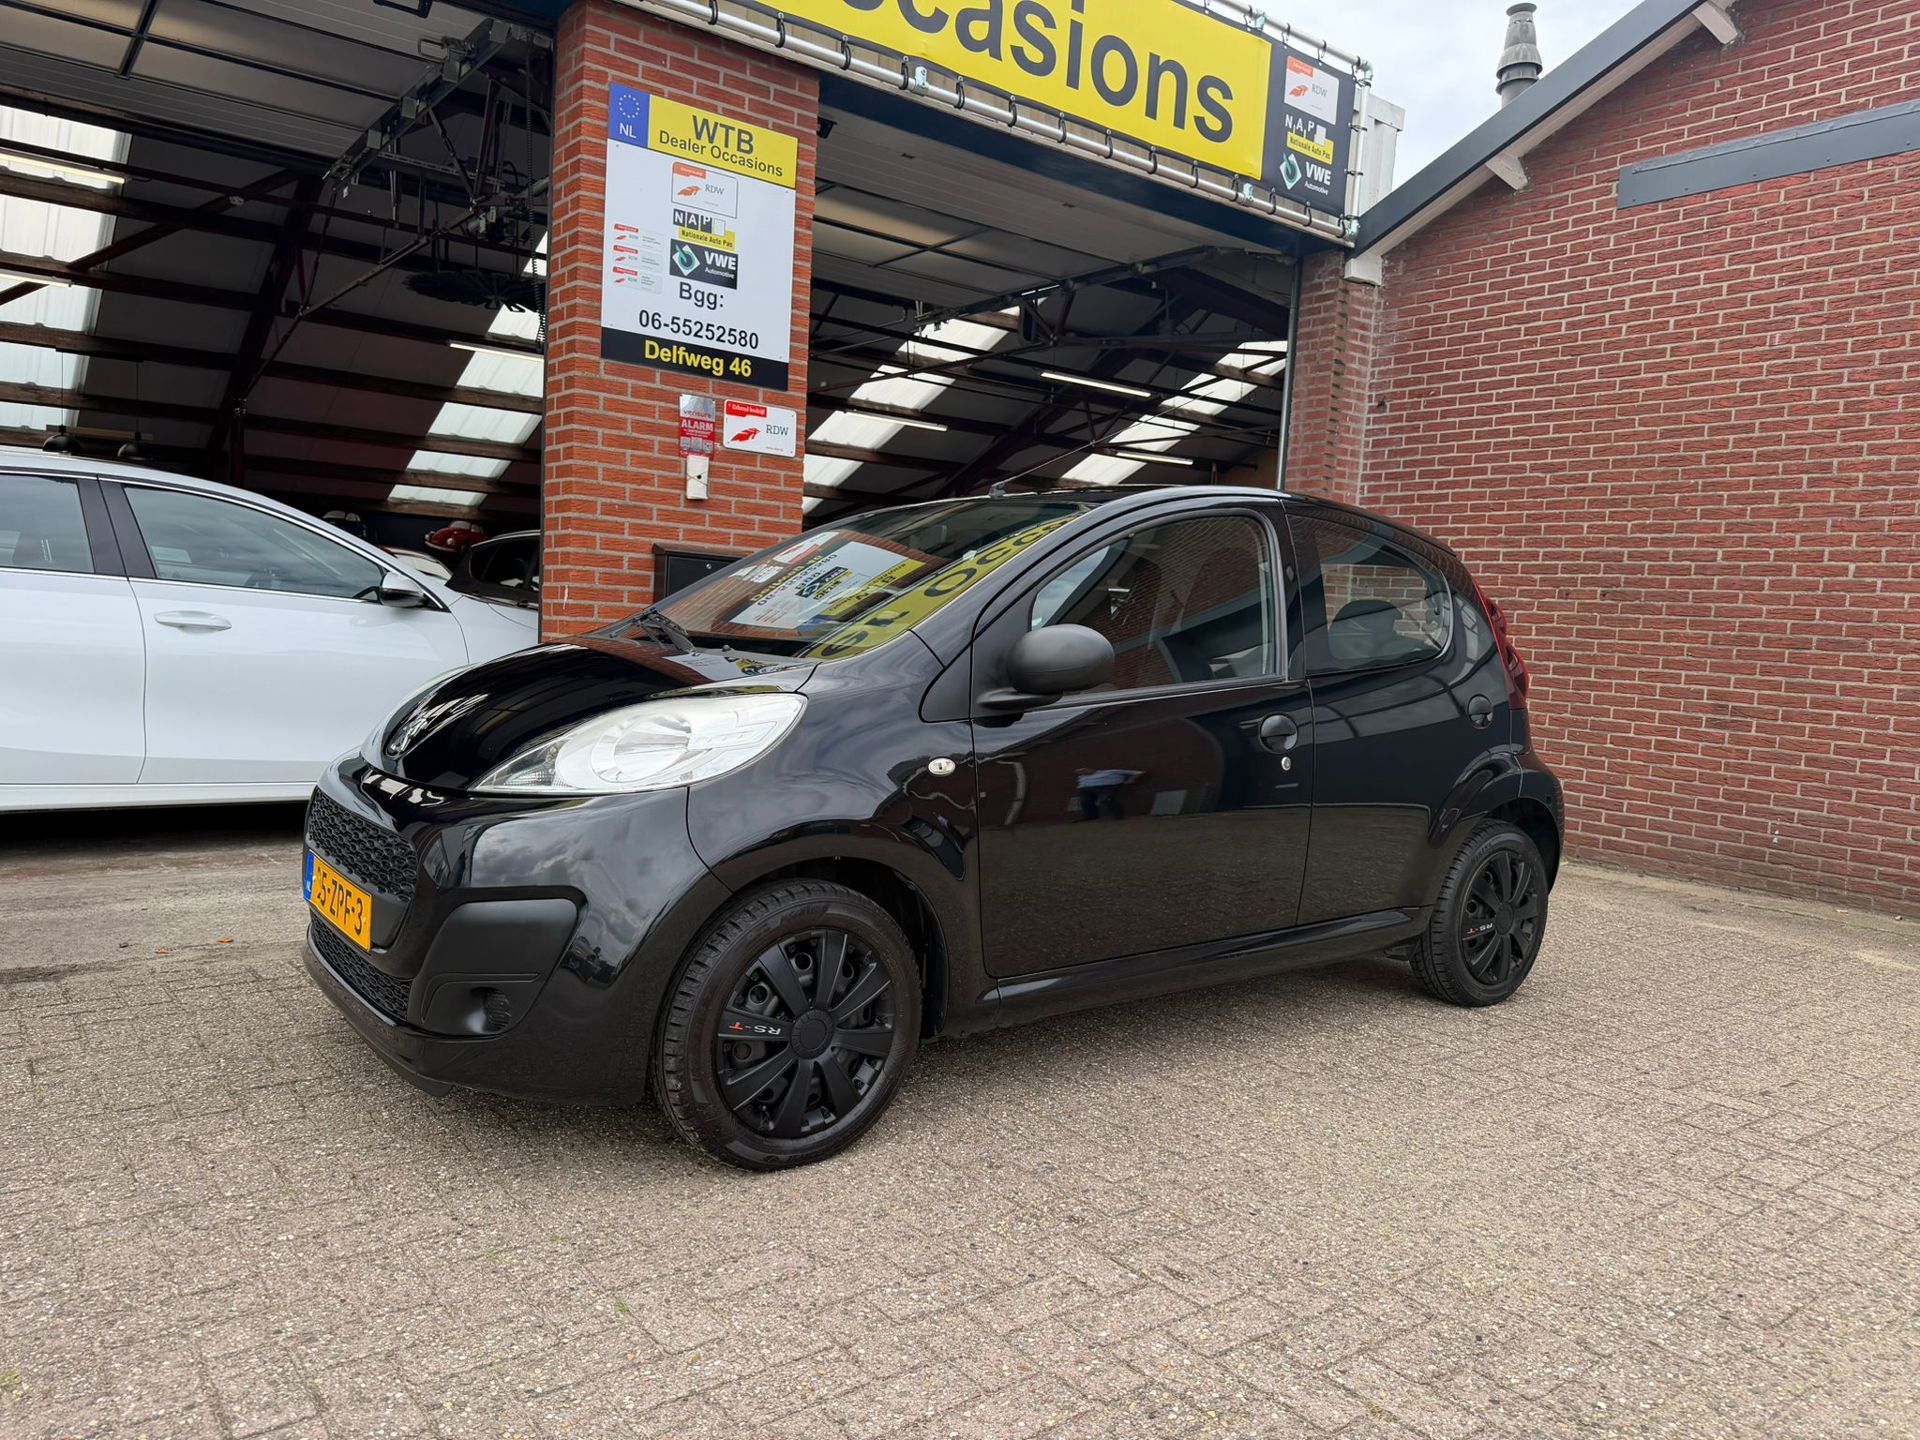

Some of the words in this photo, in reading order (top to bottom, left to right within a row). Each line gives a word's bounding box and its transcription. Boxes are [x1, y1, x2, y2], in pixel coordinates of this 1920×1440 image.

[842, 0, 1233, 143] asions
[619, 123, 637, 138] NL
[692, 115, 754, 154] WTB
[659, 130, 706, 155] Dealer
[710, 145, 783, 177] Occasions
[1306, 161, 1331, 186] VWE
[705, 184, 724, 195] RDW
[1304, 181, 1328, 196] Automotive
[681, 229, 708, 242] Nationale
[709, 236, 721, 246] Auto
[704, 250, 736, 271] VWE
[704, 267, 734, 279] Automotive
[679, 281, 724, 310] Bgg:
[638, 309, 759, 350] 06-55252580
[644, 340, 724, 376] Delfweg
[729, 357, 752, 377] 46
[681, 419, 713, 432] ALARM
[766, 424, 789, 436] RDW
[729, 1021, 782, 1036] RS-T
